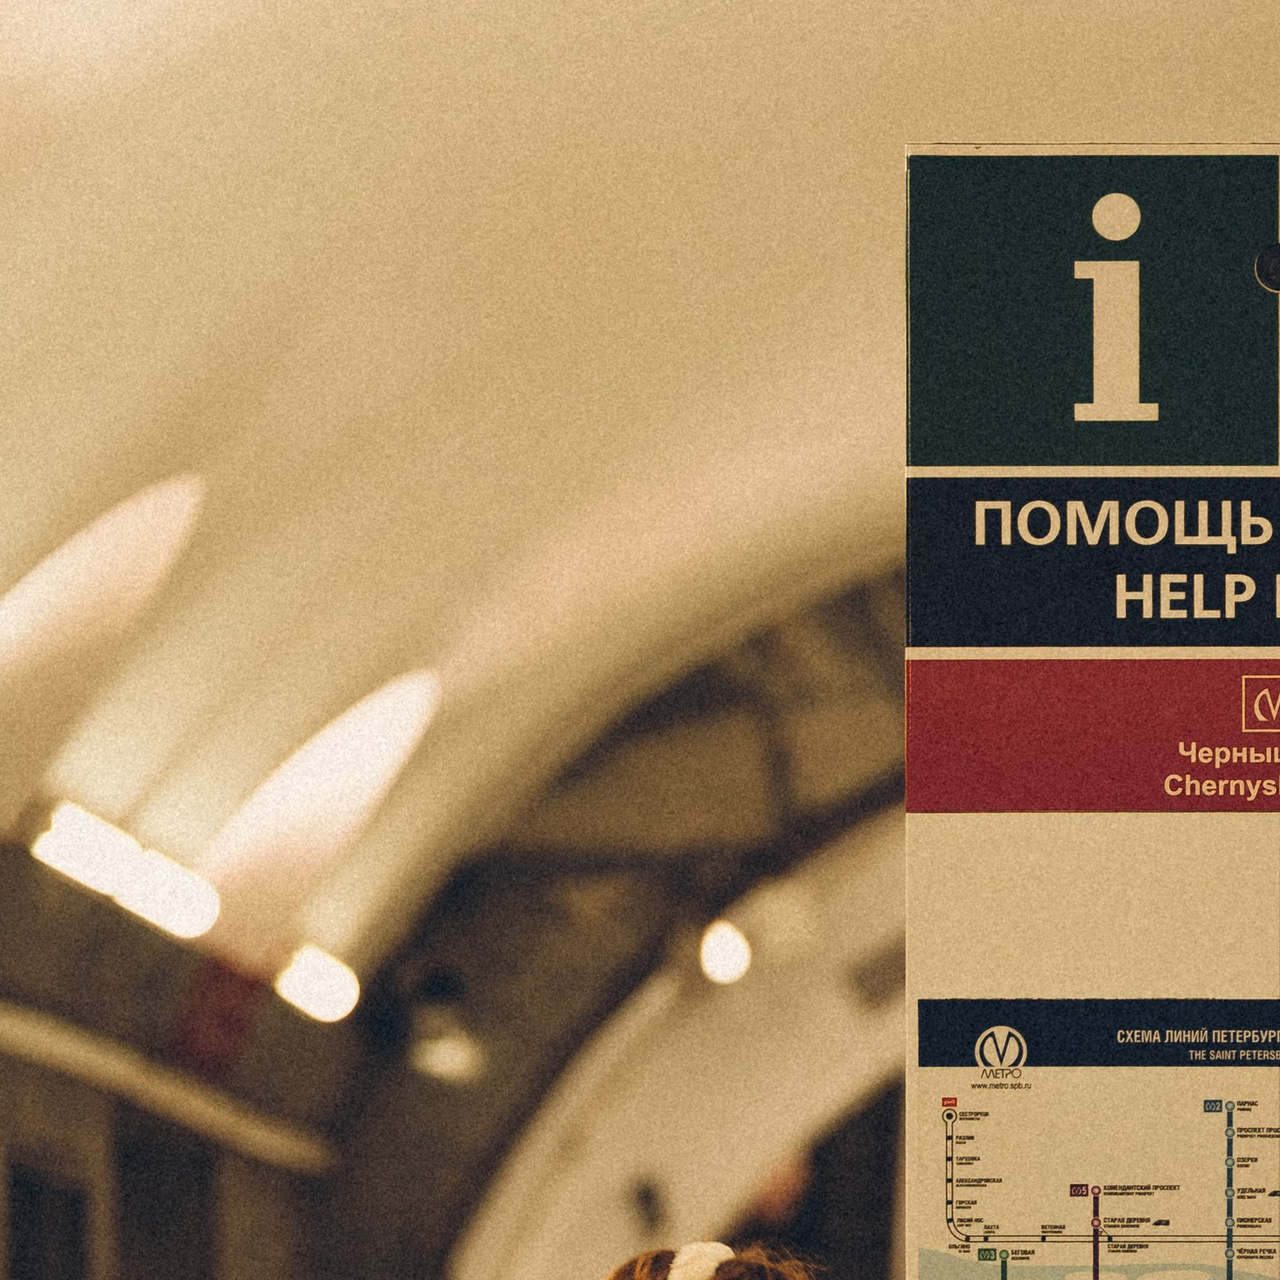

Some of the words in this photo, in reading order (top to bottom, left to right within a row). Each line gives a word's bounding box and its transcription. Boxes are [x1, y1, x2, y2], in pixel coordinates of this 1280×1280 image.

[974, 499, 1275, 554] ПОМОЩЬ
[1114, 573, 1257, 620] HELP
[1116, 1029, 1161, 1043] СХЕМА
[1165, 1026, 1208, 1043] ЛИНИЙ
[1189, 1050, 1206, 1060] THE
[1209, 1050, 1237, 1060] SAINT
[971, 1082, 1032, 1090] www.metro.spb.ru
